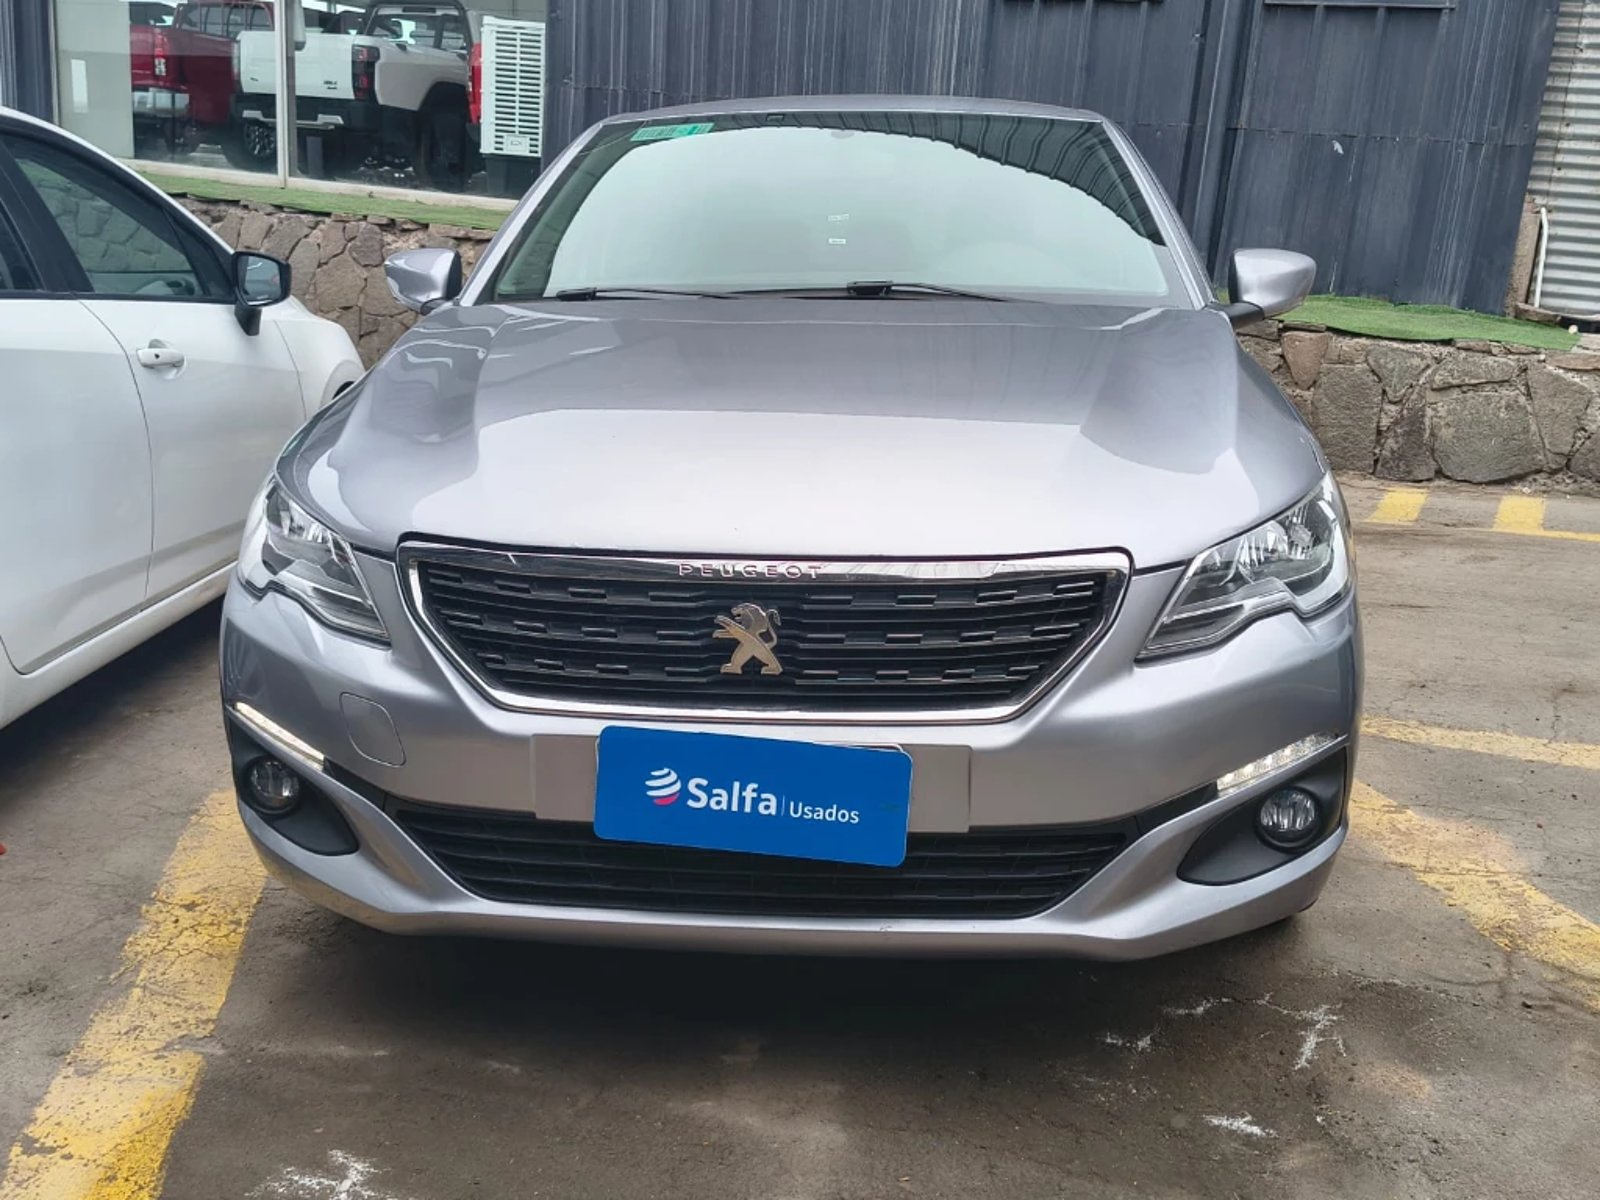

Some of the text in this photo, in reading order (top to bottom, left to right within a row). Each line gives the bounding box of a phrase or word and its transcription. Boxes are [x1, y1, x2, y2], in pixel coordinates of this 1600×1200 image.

[678, 563, 822, 579] PEUGEOT
[686, 777, 860, 824] Salfa Usados
